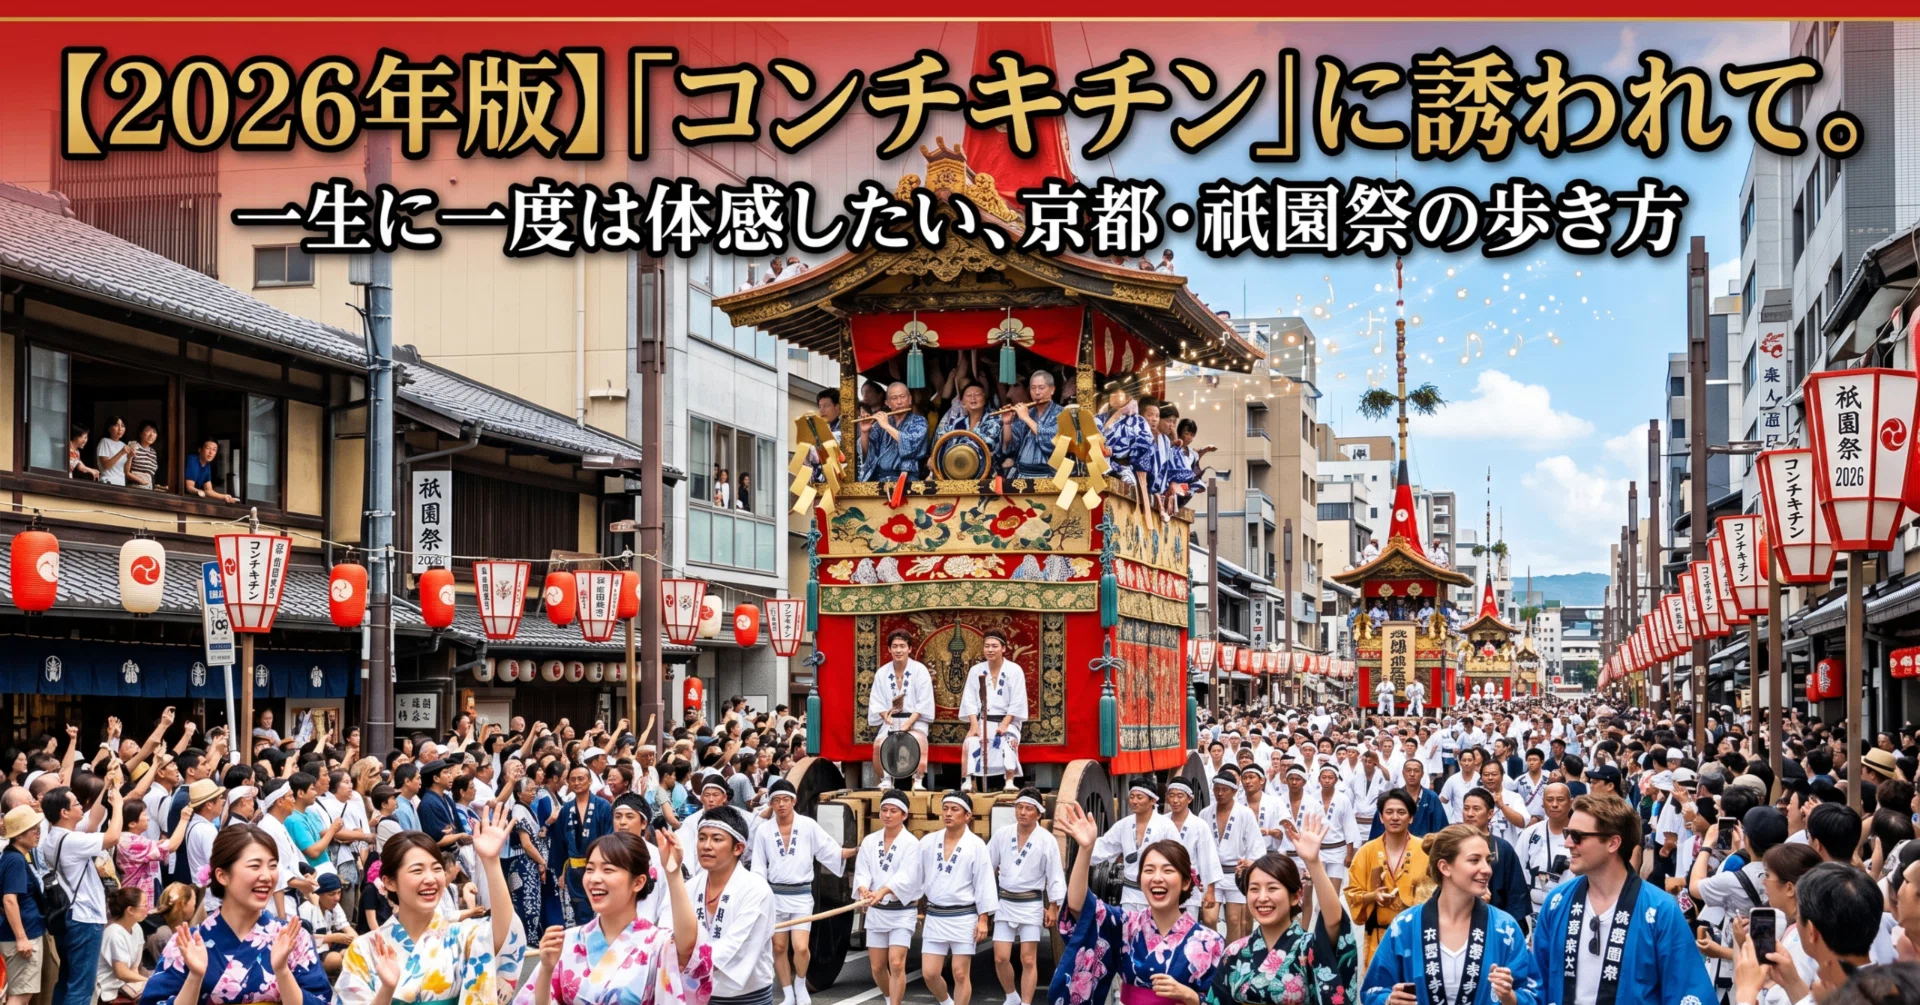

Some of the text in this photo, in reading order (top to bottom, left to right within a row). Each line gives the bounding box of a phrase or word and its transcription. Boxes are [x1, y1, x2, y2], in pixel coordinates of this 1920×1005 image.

[1835, 385, 1862, 460] 祇園祭
[1784, 458, 1804, 539] コンチキチン
[1835, 466, 1864, 487] 2026
[419, 478, 443, 551] 祇園祭
[248, 541, 260, 600] コンチキチン
[1734, 523, 1748, 582] コンチキチン
